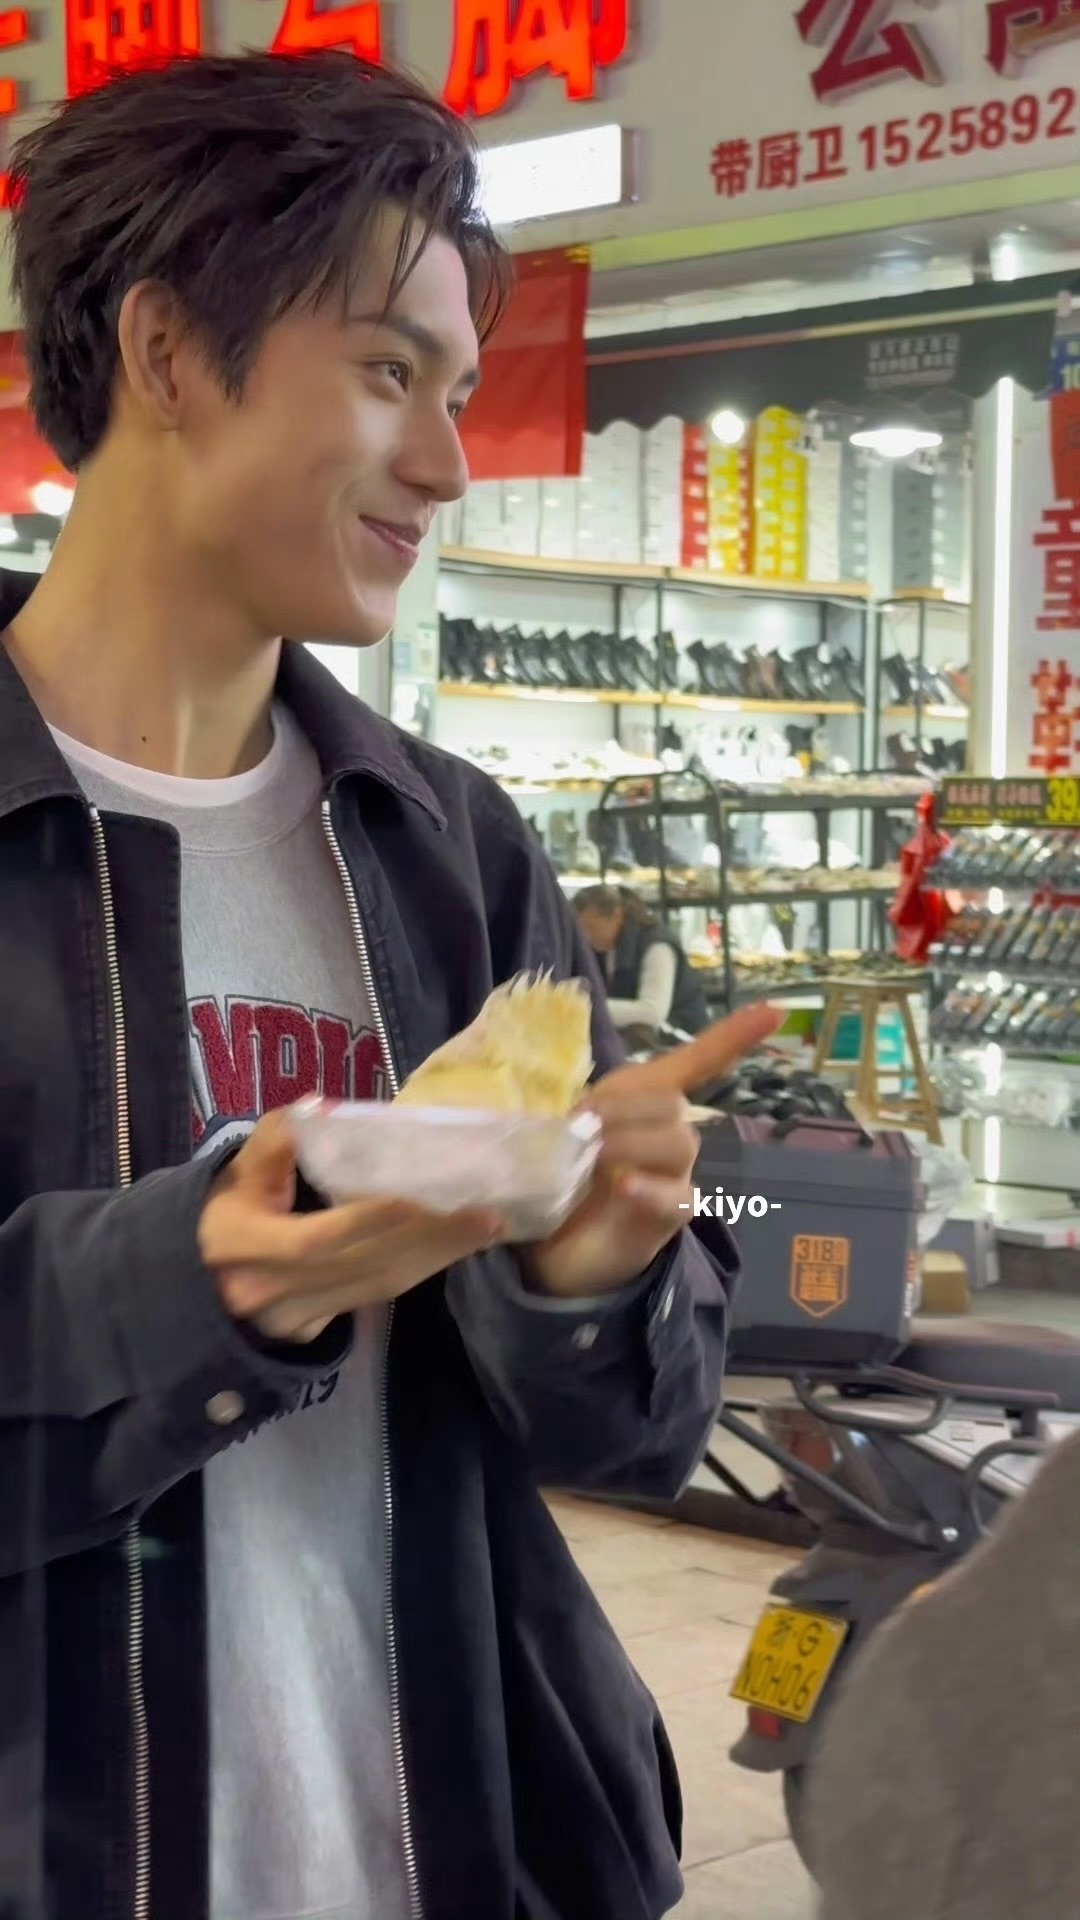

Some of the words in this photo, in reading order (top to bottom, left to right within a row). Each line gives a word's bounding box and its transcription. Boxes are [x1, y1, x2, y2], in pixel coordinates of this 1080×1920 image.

[710, 125, 847, 198] 带厨卫
[795, 1239, 835, 1262] 318
